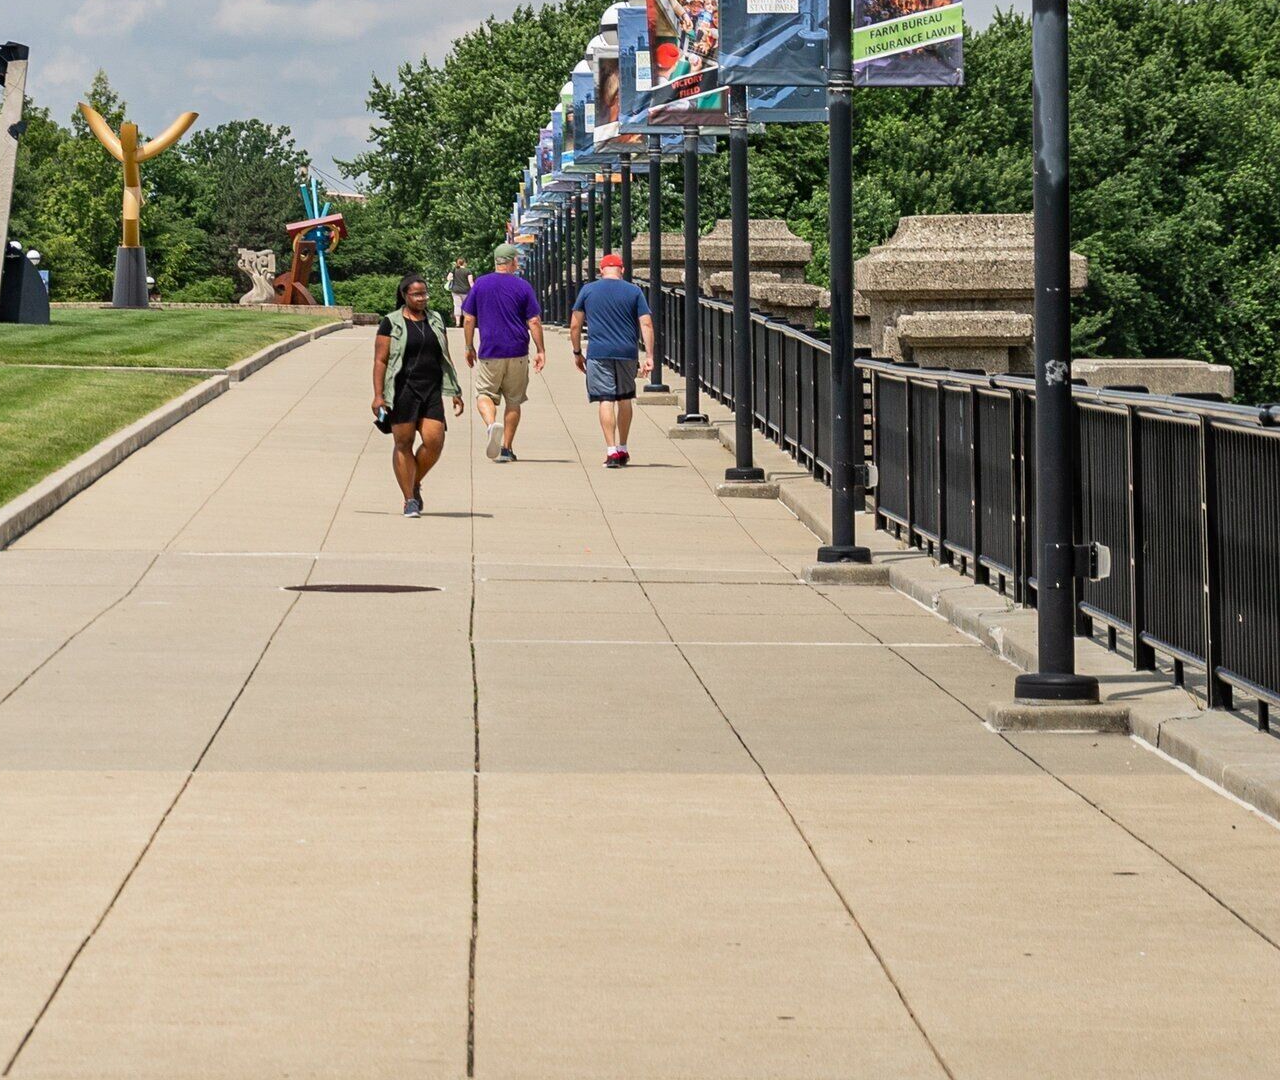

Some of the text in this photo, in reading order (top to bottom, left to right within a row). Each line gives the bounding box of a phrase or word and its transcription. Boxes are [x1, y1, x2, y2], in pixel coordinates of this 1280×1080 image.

[869, 13, 943, 39] FARM BUREAU
[865, 25, 956, 55] INSURANCE LAWN
[671, 73, 703, 90] VICTORY
[680, 86, 701, 98] FIELD
